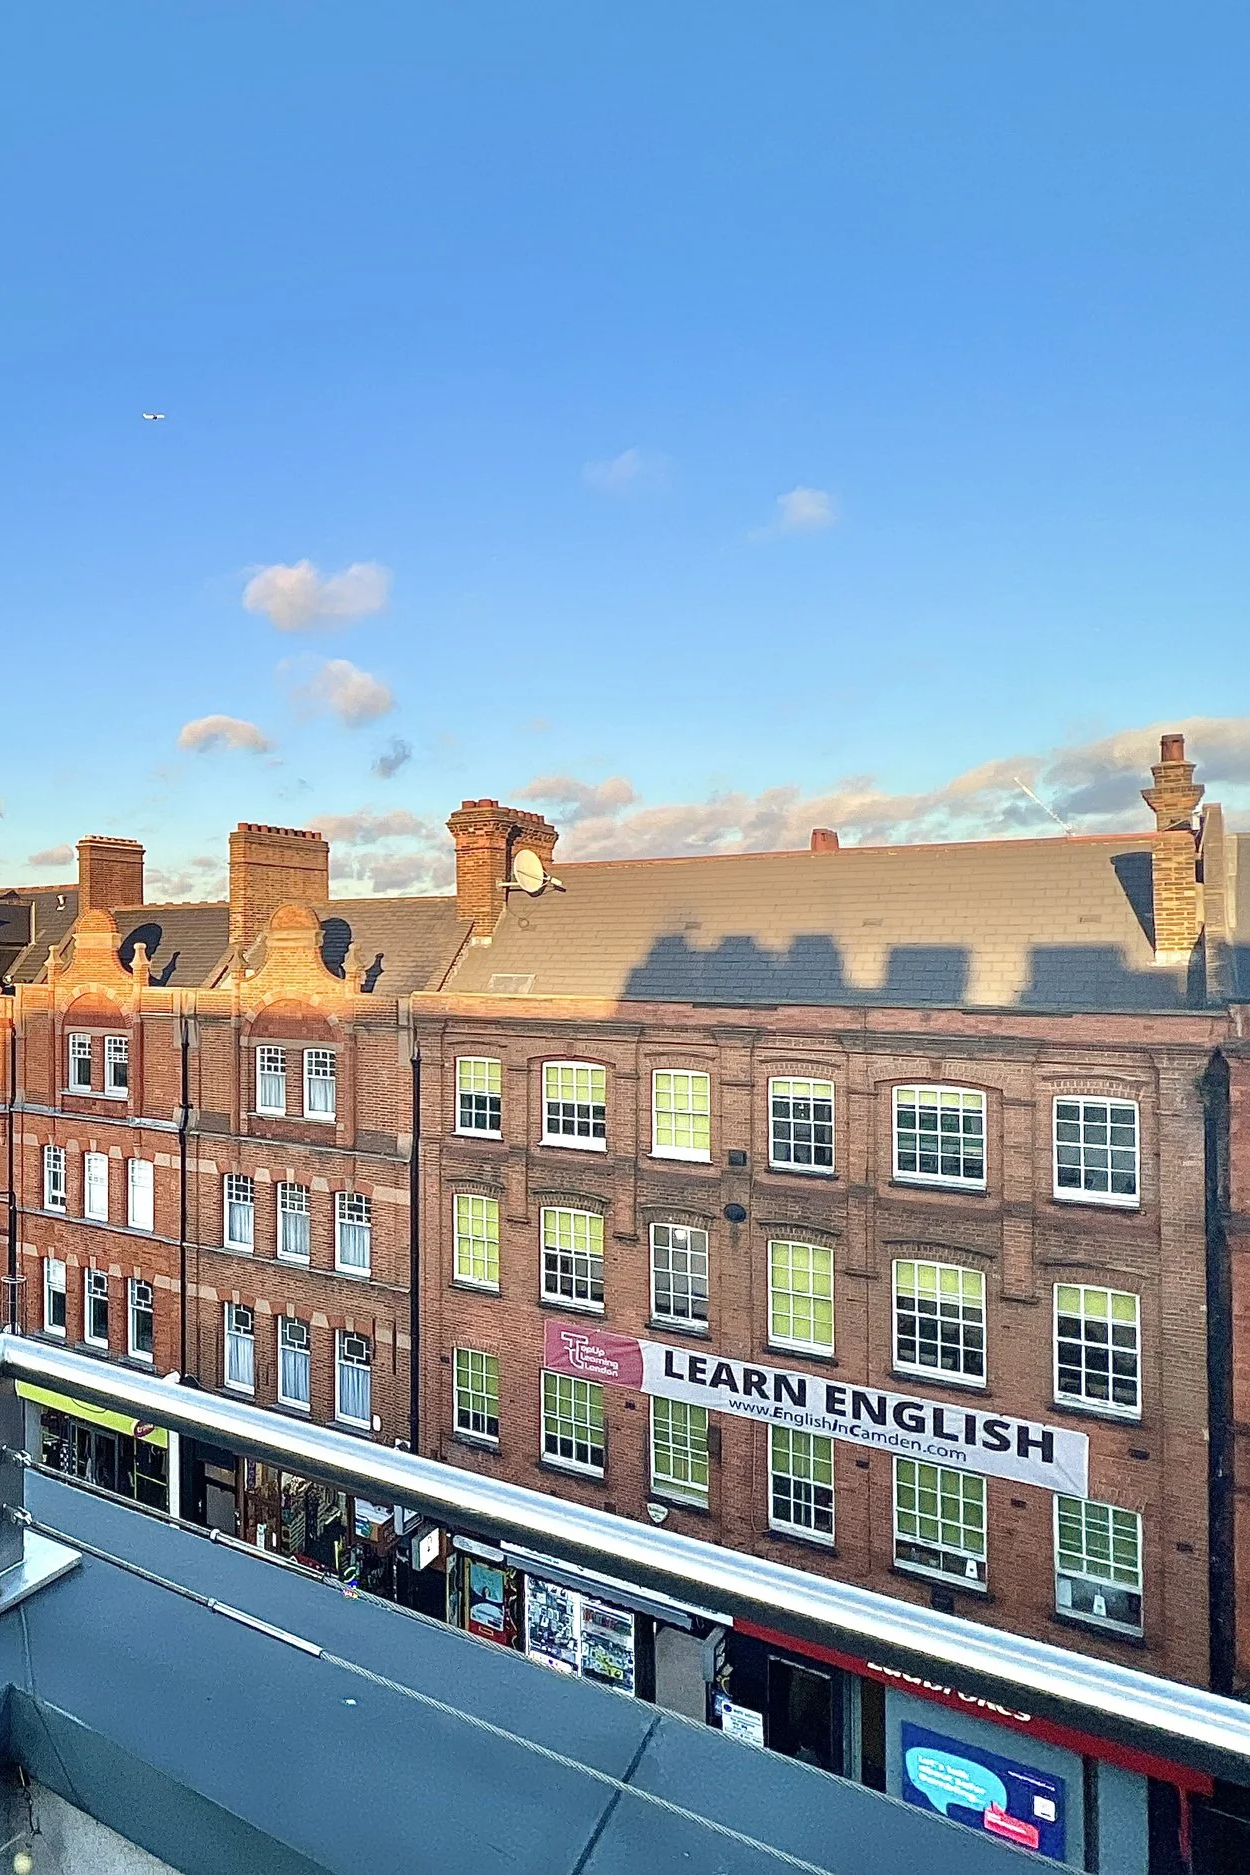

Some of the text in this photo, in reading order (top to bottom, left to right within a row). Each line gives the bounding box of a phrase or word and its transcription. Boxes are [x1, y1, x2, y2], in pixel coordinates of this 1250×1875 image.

[580, 1352, 618, 1370] Learning
[584, 1362, 619, 1377] London
[664, 1350, 1054, 1464] LEARN ENGLISH
[728, 1398, 967, 1462] www.EnglishInCamden.com
